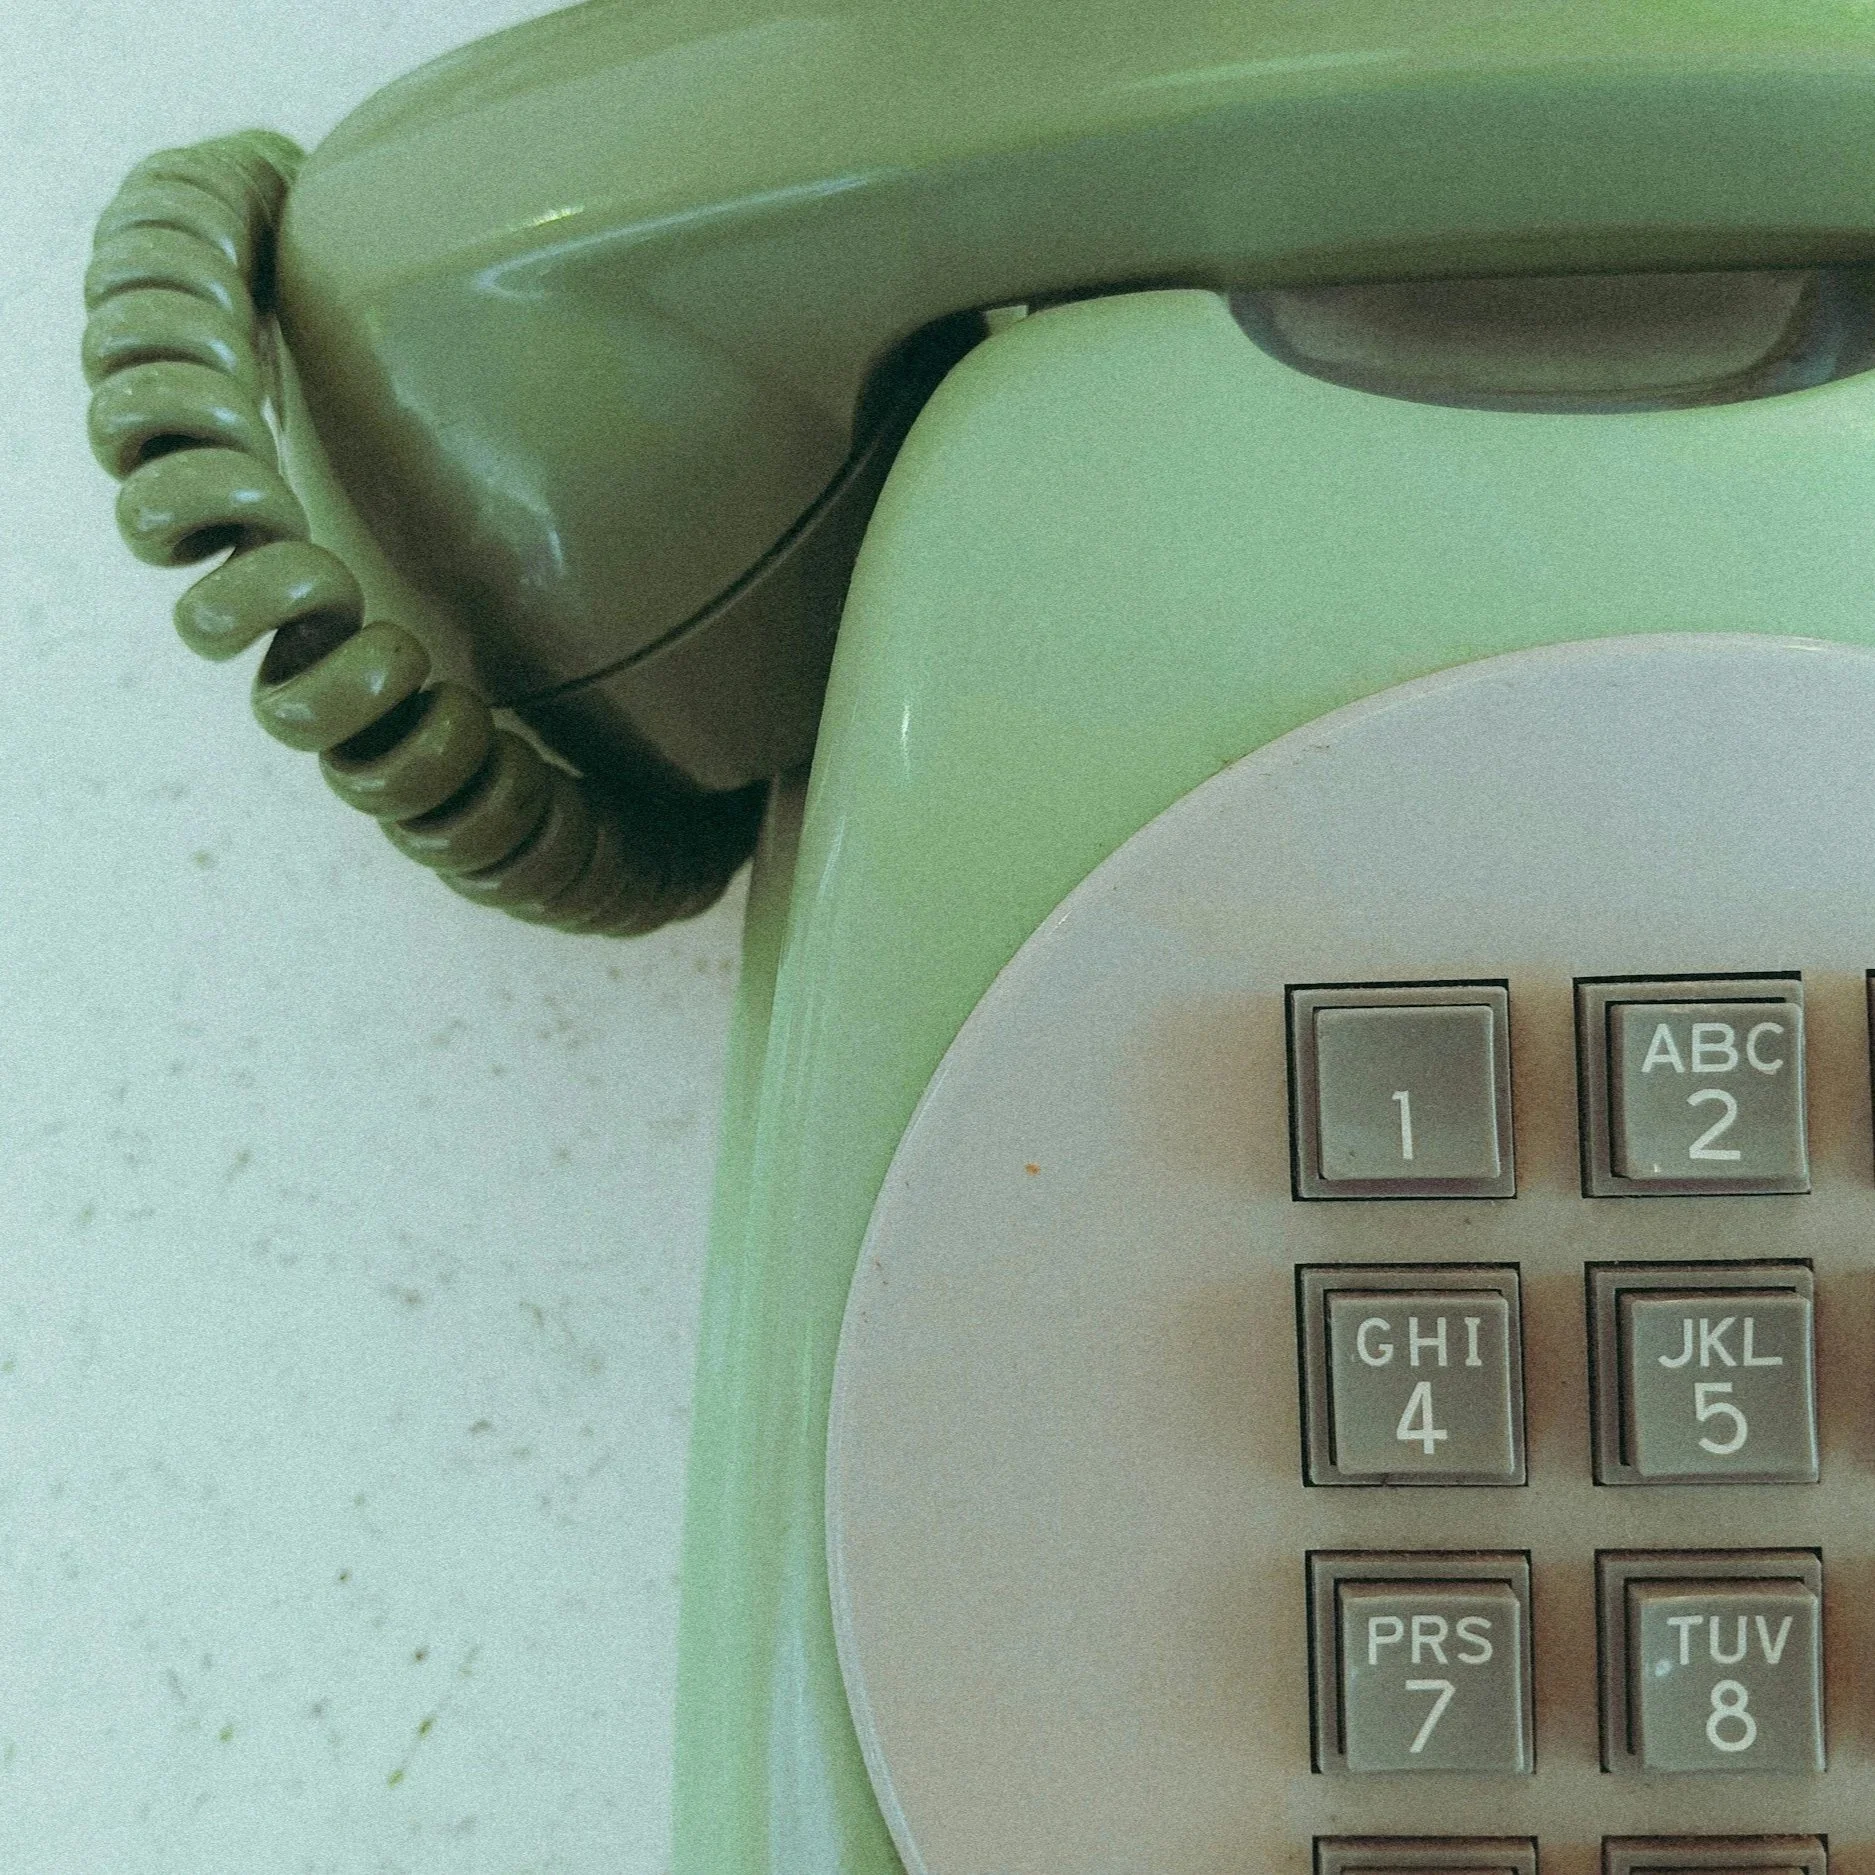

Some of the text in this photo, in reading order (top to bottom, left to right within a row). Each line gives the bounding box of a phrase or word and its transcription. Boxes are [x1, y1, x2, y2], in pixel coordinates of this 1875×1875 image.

[1641, 1021, 1785, 1074] ABC
[1391, 1090, 1414, 1160] 1
[1686, 1088, 1742, 1161] 2
[1355, 1316, 1483, 1368] GHI
[1657, 1316, 1784, 1368] JKL
[1396, 1380, 1448, 1455] 4
[1693, 1382, 1748, 1455] 5
[1366, 1614, 1494, 1666] PRS
[1666, 1614, 1793, 1666] TUV
[1404, 1679, 1456, 1754] 7
[1705, 1679, 1758, 1753] 8
